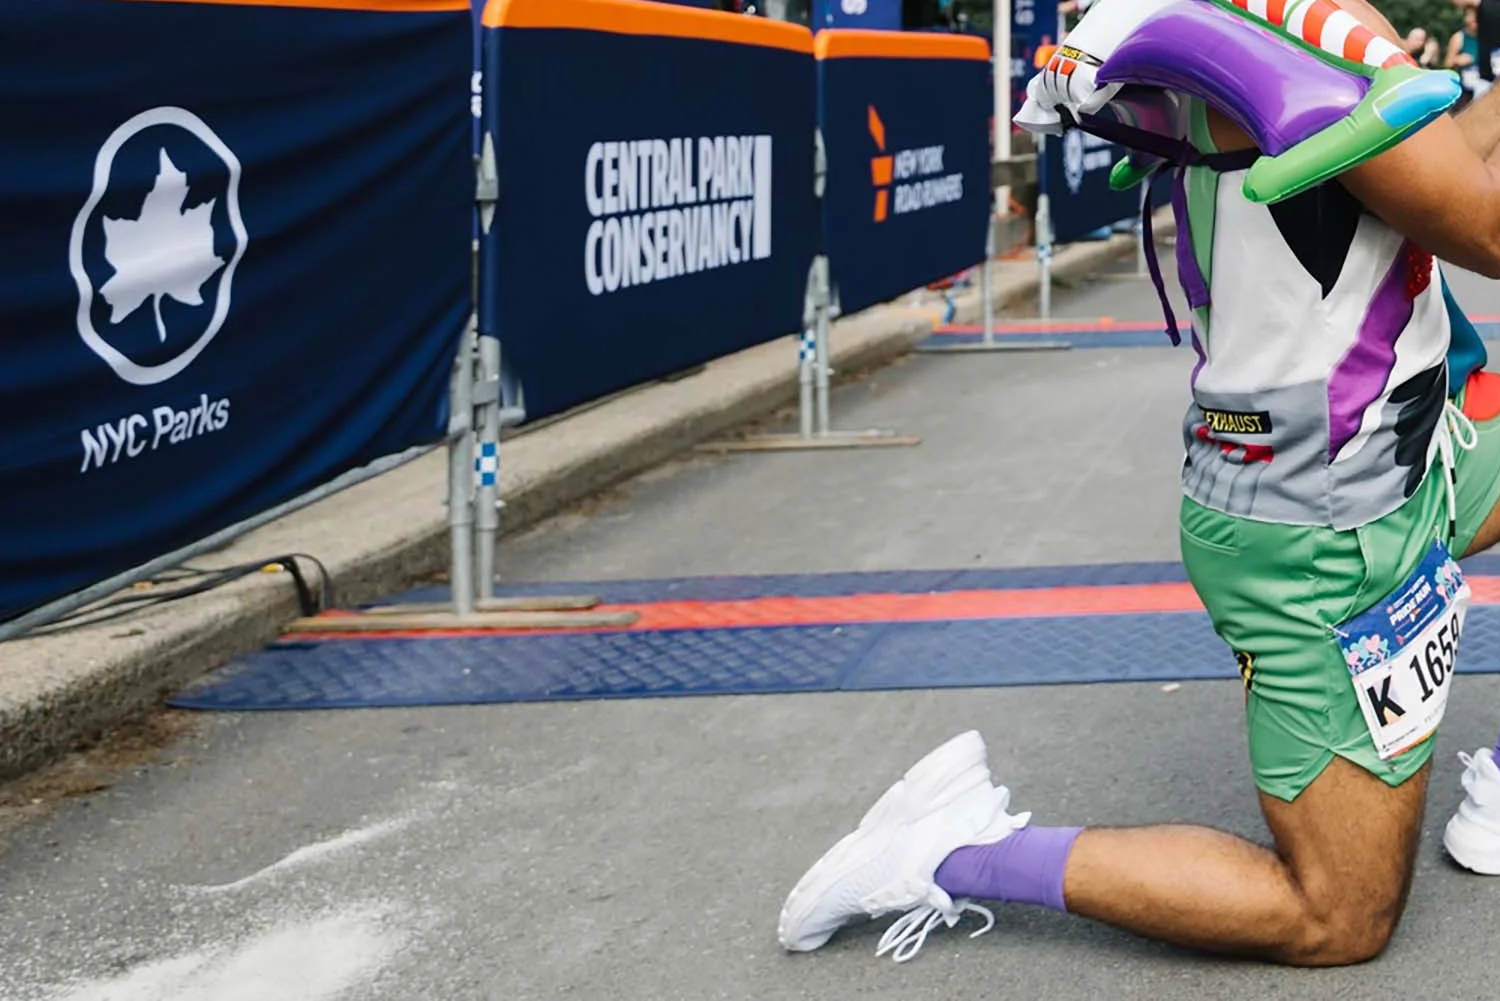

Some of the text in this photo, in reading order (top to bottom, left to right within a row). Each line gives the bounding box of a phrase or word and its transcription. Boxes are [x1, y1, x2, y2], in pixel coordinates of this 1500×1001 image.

[584, 135, 754, 218] CENTRAL PARK
[584, 199, 754, 296] CONSERVANCY
[79, 393, 231, 474] NYC Parks
[1205, 411, 1263, 433] EXHAUST
[1366, 674, 1407, 728] K
